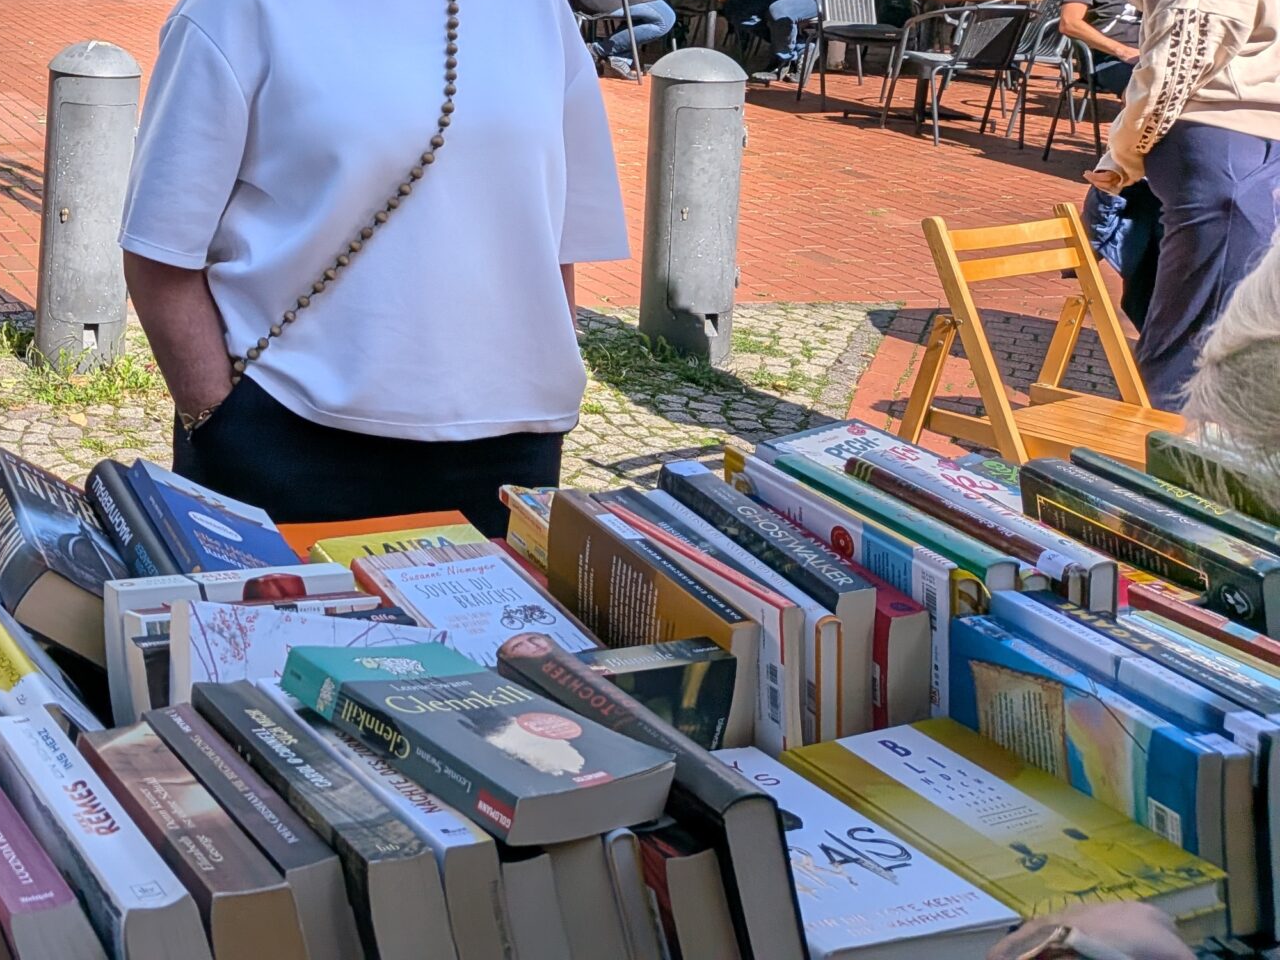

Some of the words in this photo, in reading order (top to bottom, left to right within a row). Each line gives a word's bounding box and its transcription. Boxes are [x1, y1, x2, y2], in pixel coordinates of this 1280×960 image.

[91, 475, 133, 546] MACHTVERFALL
[634, 540, 663, 561] WEHTUN
[736, 505, 855, 588] GHOSTWALKER
[401, 571, 441, 582] Susanne
[447, 564, 496, 575] Niemeyer
[660, 559, 694, 586] BISSCHEN
[415, 580, 469, 599] SOVIEL
[469, 576, 493, 590] DU
[454, 587, 523, 609] BRAUCHST
[692, 583, 707, 596] EIN
[706, 593, 726, 610] WIRD
[725, 607, 742, 621] DAS
[1057, 602, 1155, 651] Y-GAME
[385, 682, 535, 716] Glennkill
[391, 682, 425, 693] Leonie
[430, 679, 472, 691] Swann
[542, 660, 611, 716] TOCHTER
[38, 728, 61, 755] HERZ
[270, 724, 297, 748] SUCH
[340, 698, 411, 760] Glennkill
[415, 746, 441, 773] Swann
[878, 739, 912, 758] B
[57, 754, 73, 771] INS
[298, 762, 332, 790] CAROL
[372, 754, 399, 783] DES
[443, 767, 471, 793] Leonie
[64, 779, 120, 837] REMES
[245, 789, 281, 827] GRISHAM
[392, 773, 443, 817] NÄCHTE
[477, 802, 511, 830] GOLDMANN
[273, 821, 299, 846] JOHN
[178, 836, 216, 872] Elizabeth
[196, 833, 224, 865] George
[0, 844, 34, 886] LUCINDA
[927, 891, 980, 909] KENNT
